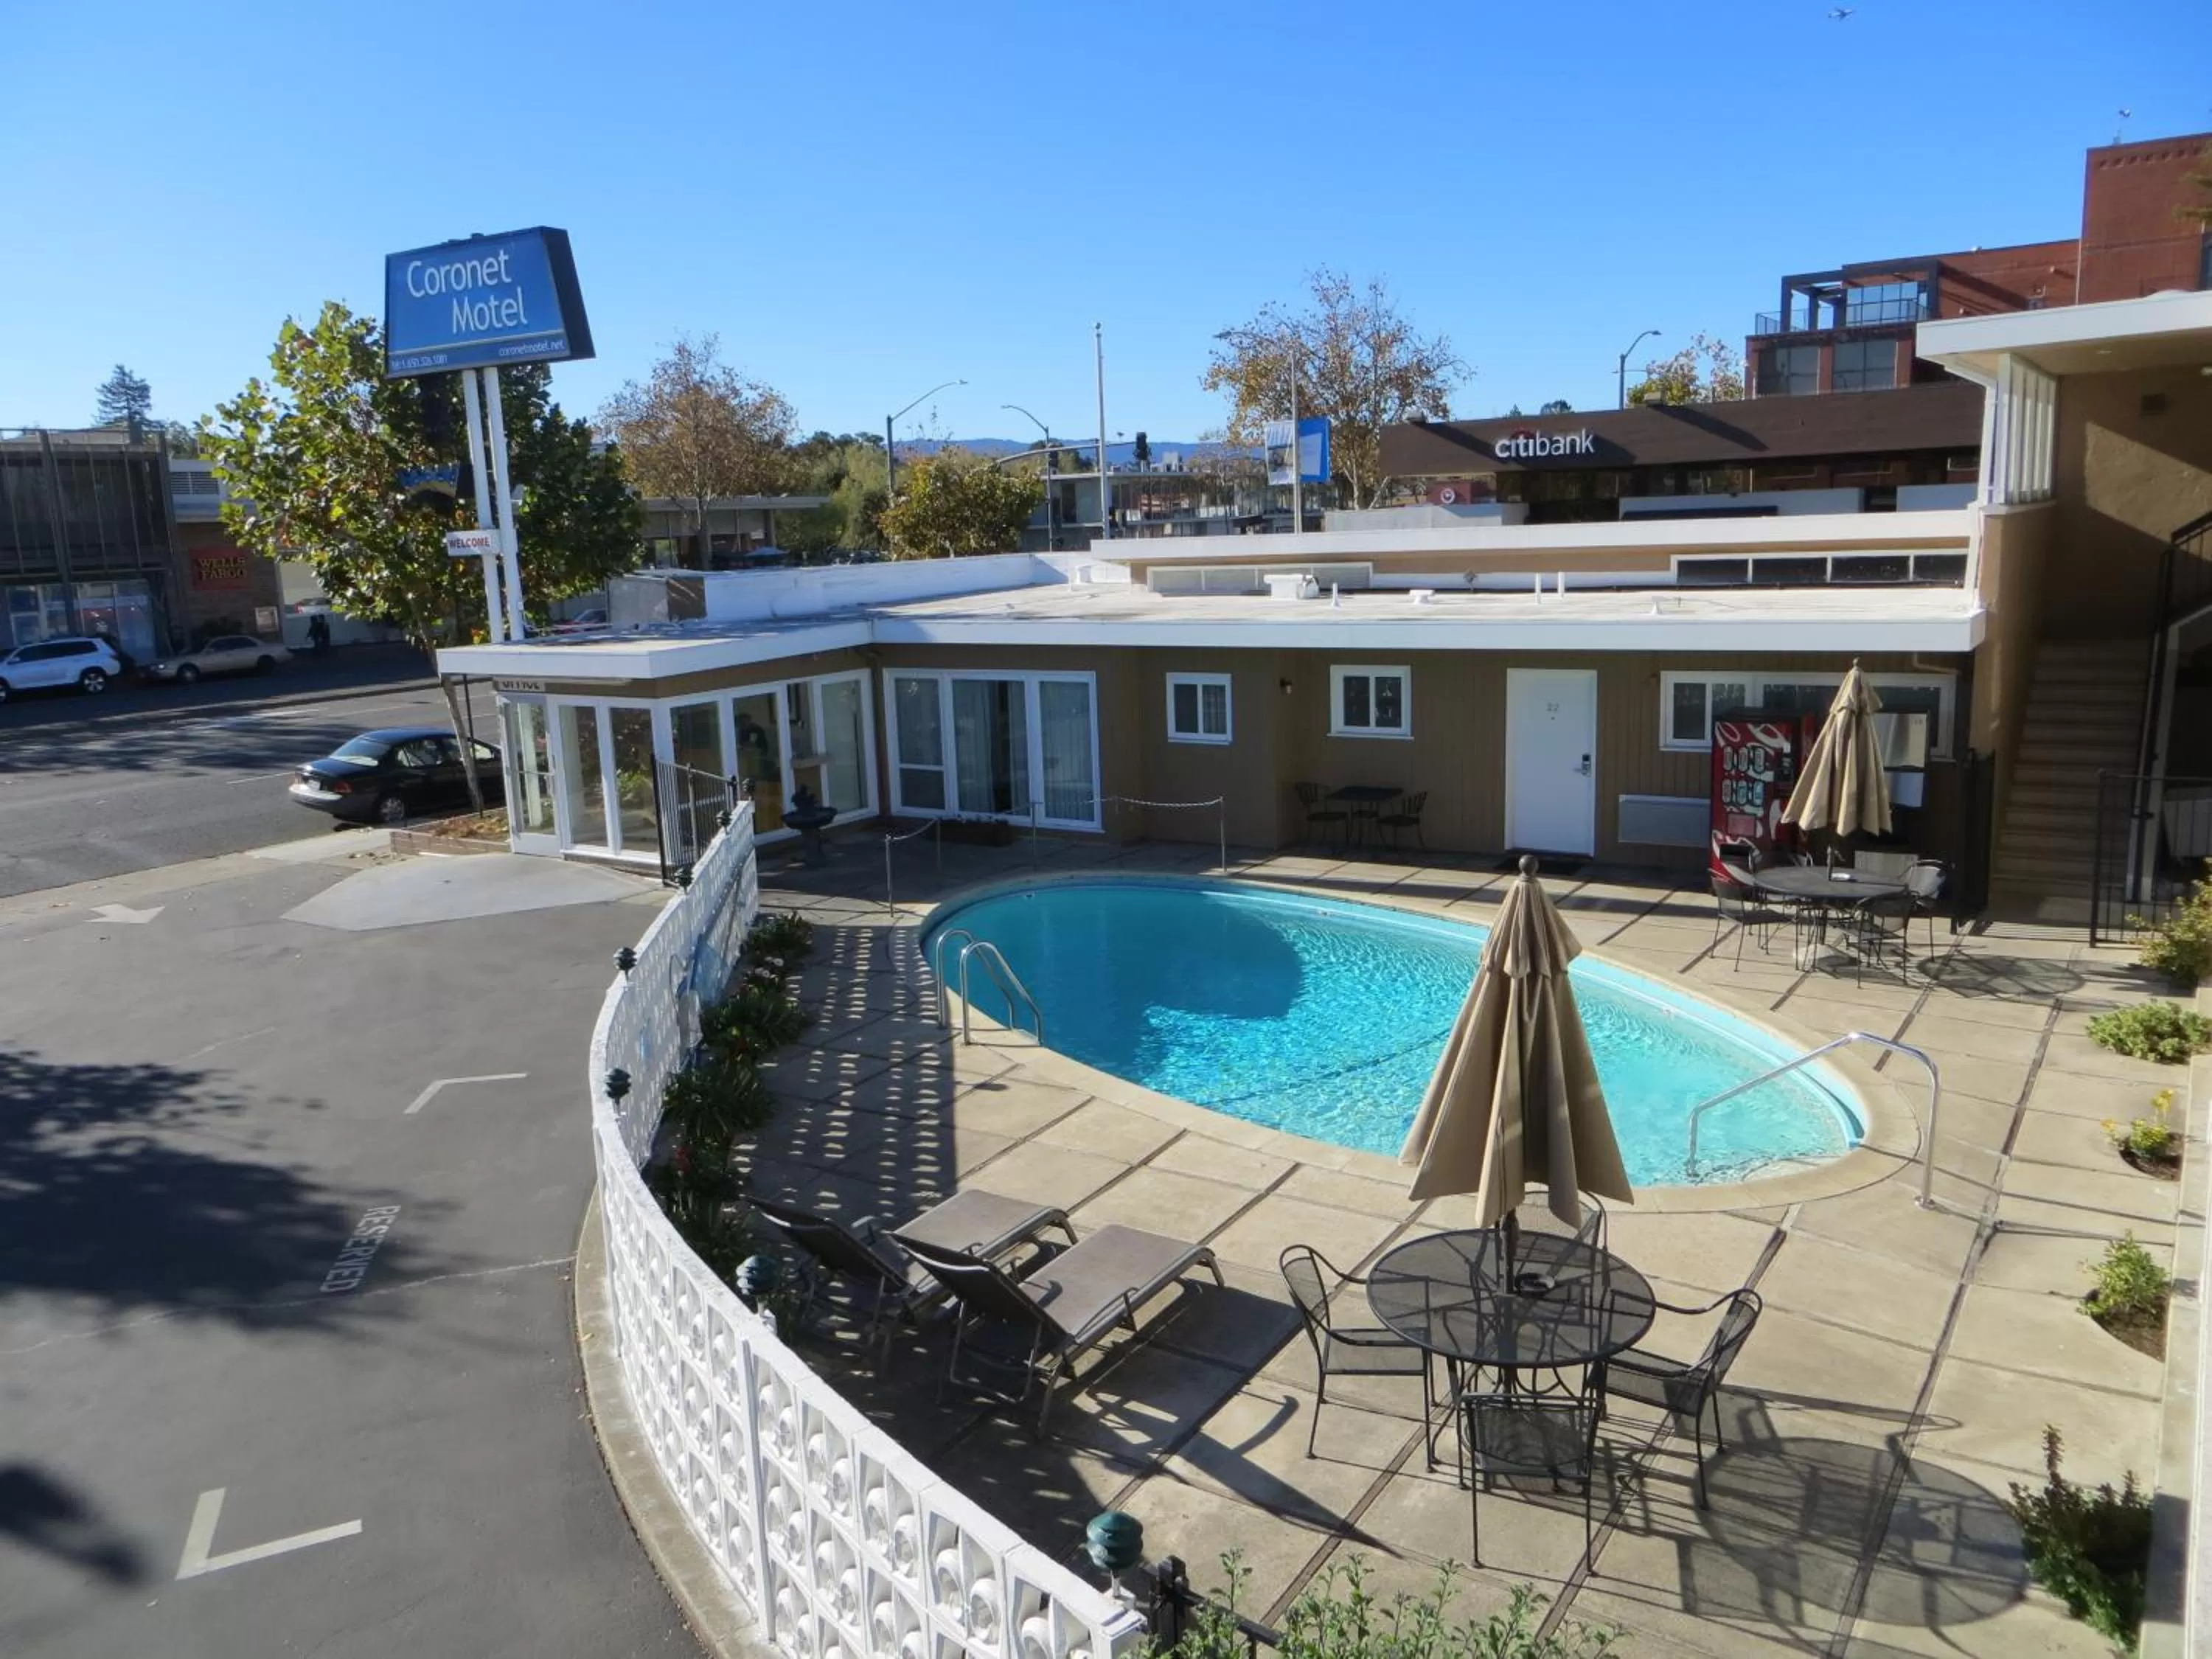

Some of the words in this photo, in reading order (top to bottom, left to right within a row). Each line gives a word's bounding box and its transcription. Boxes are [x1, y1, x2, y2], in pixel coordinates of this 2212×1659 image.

[406, 249, 512, 298] Coronet
[452, 286, 528, 334] Motel
[1495, 427, 1595, 458] citibank
[448, 537, 490, 549] WELCOME
[319, 1205, 402, 1293] RESERVED
